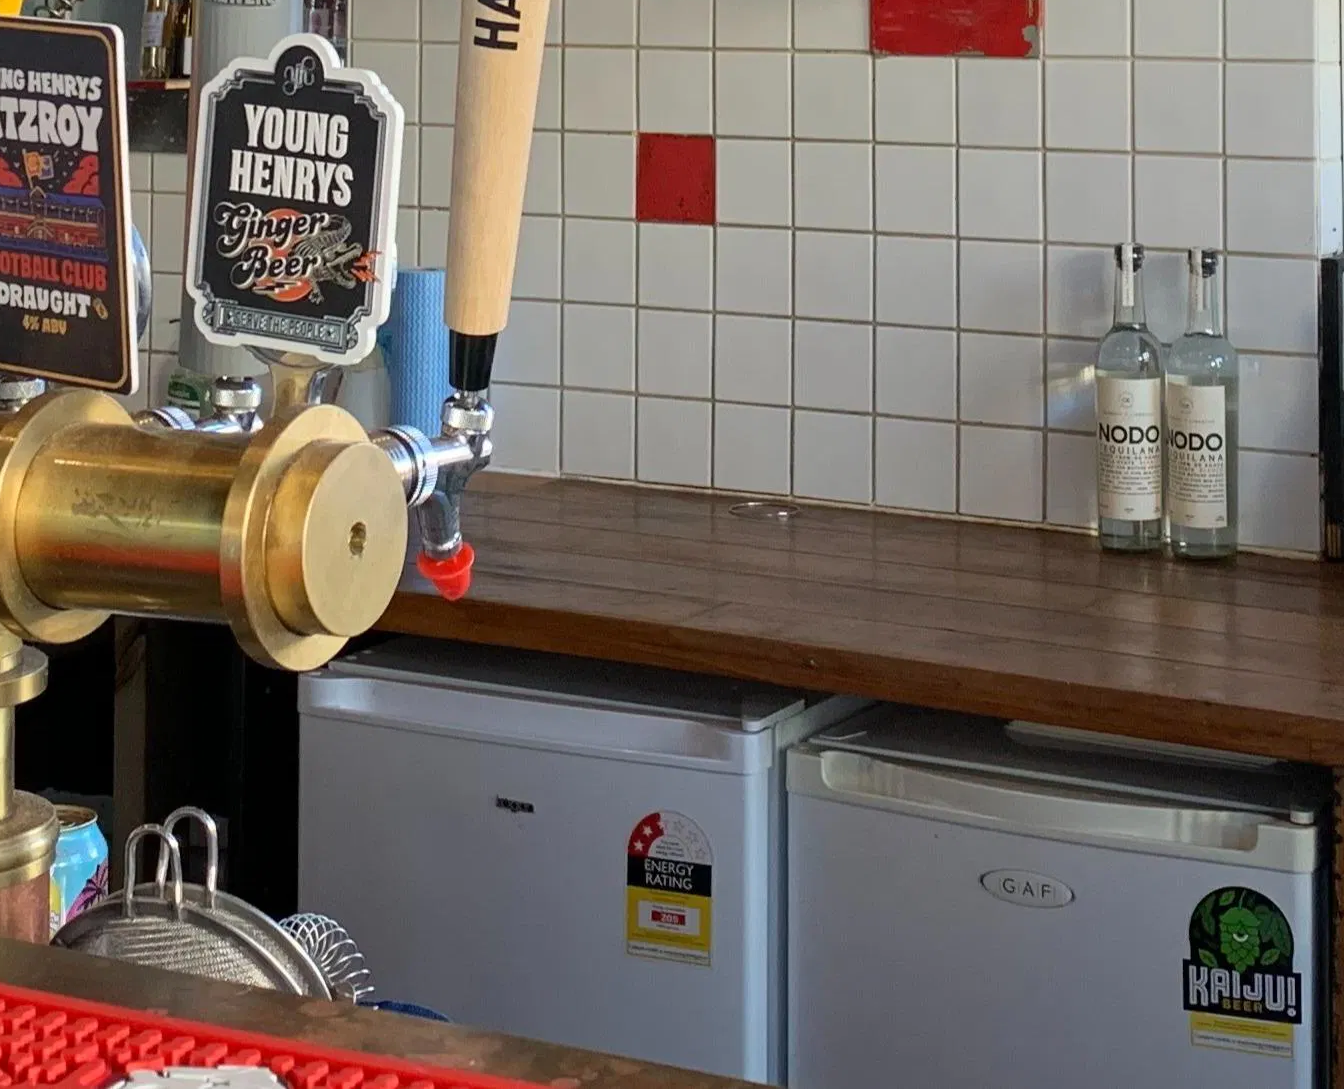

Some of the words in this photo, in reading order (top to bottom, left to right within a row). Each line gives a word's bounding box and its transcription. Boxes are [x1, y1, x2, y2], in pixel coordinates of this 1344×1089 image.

[27, 70, 103, 103] HENRYS
[243, 103, 350, 159] YOUNG
[229, 149, 354, 207] HENRYS
[213, 201, 330, 258] Ginger
[61, 262, 108, 292] CLUB
[230, 244, 321, 291] Beer
[41, 316, 68, 335] ABV
[1099, 422, 1160, 444] NODO
[1166, 429, 1223, 451] NODO
[644, 858, 695, 877] ENERGY
[645, 872, 693, 890] RATING
[1188, 965, 1297, 1017] KAIJU!
[1222, 997, 1263, 1014] BEER
